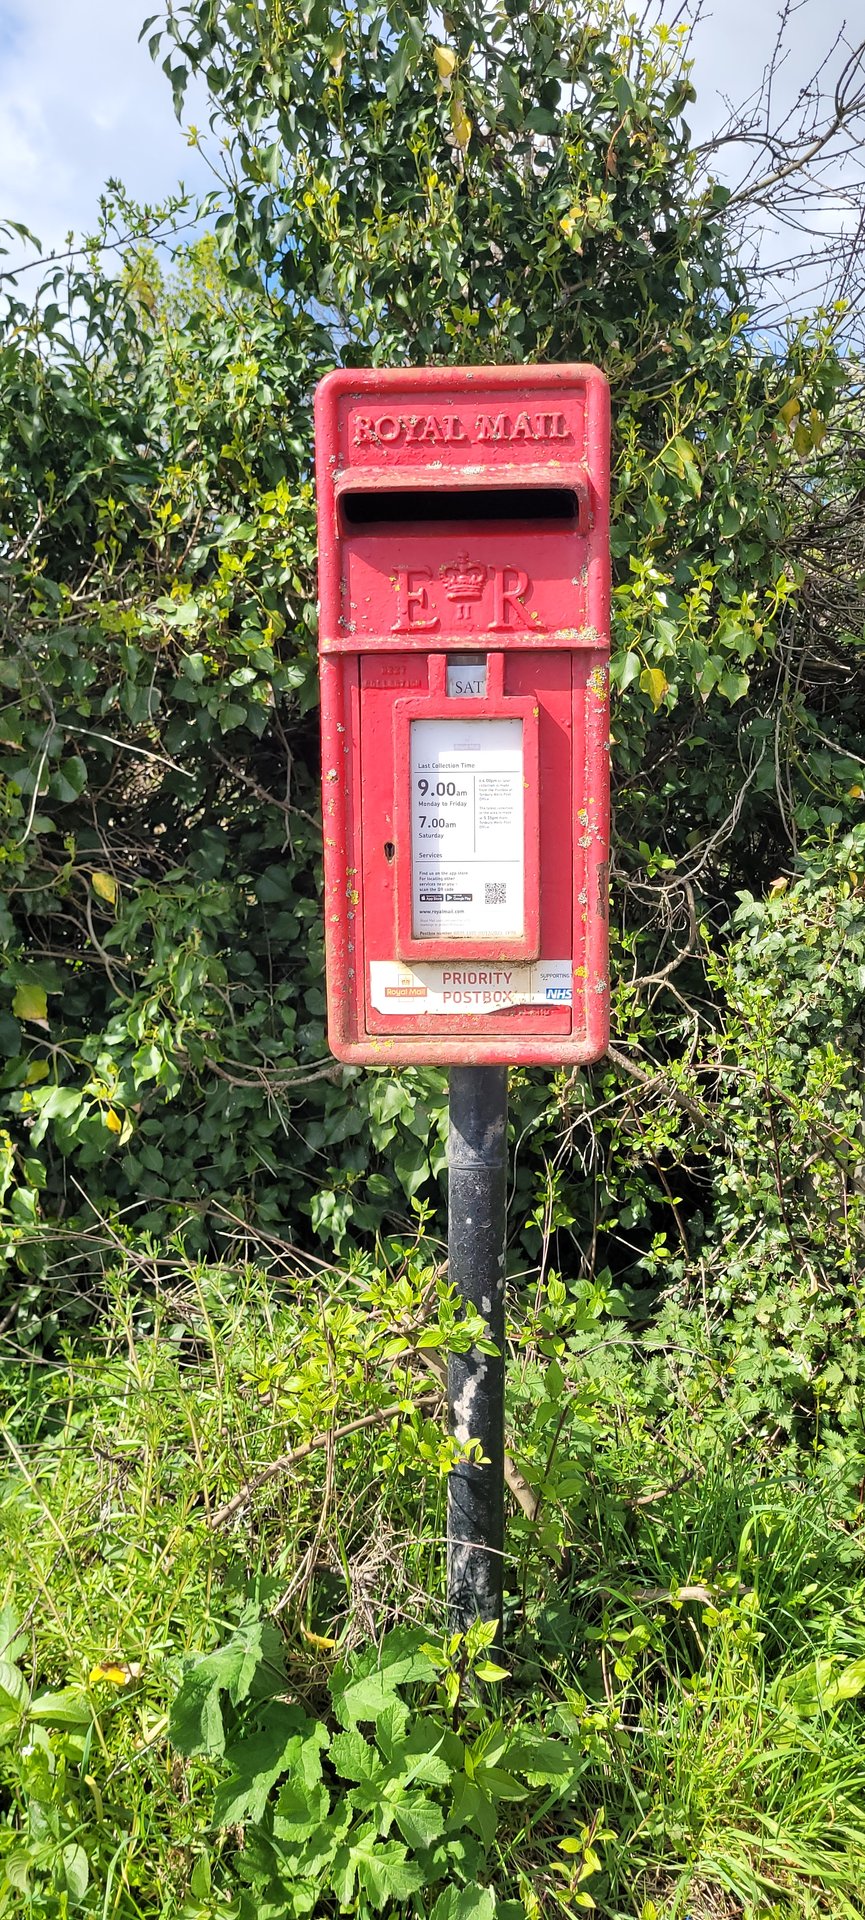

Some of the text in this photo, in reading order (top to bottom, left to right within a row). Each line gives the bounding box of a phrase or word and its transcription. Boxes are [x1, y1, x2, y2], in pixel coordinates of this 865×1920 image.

[352, 411, 573, 444] ROYAL MAIL
[391, 566, 548, 633] E R
[456, 602, 472, 620] II
[455, 680, 484, 694] SAT
[418, 779, 467, 796] 9.00am
[418, 816, 457, 829] 7.00am
[442, 972, 513, 985] PRIORITY
[386, 988, 427, 997] Royal Mail
[442, 991, 513, 1004] POSTBOX
[546, 988, 573, 1000] NHS
